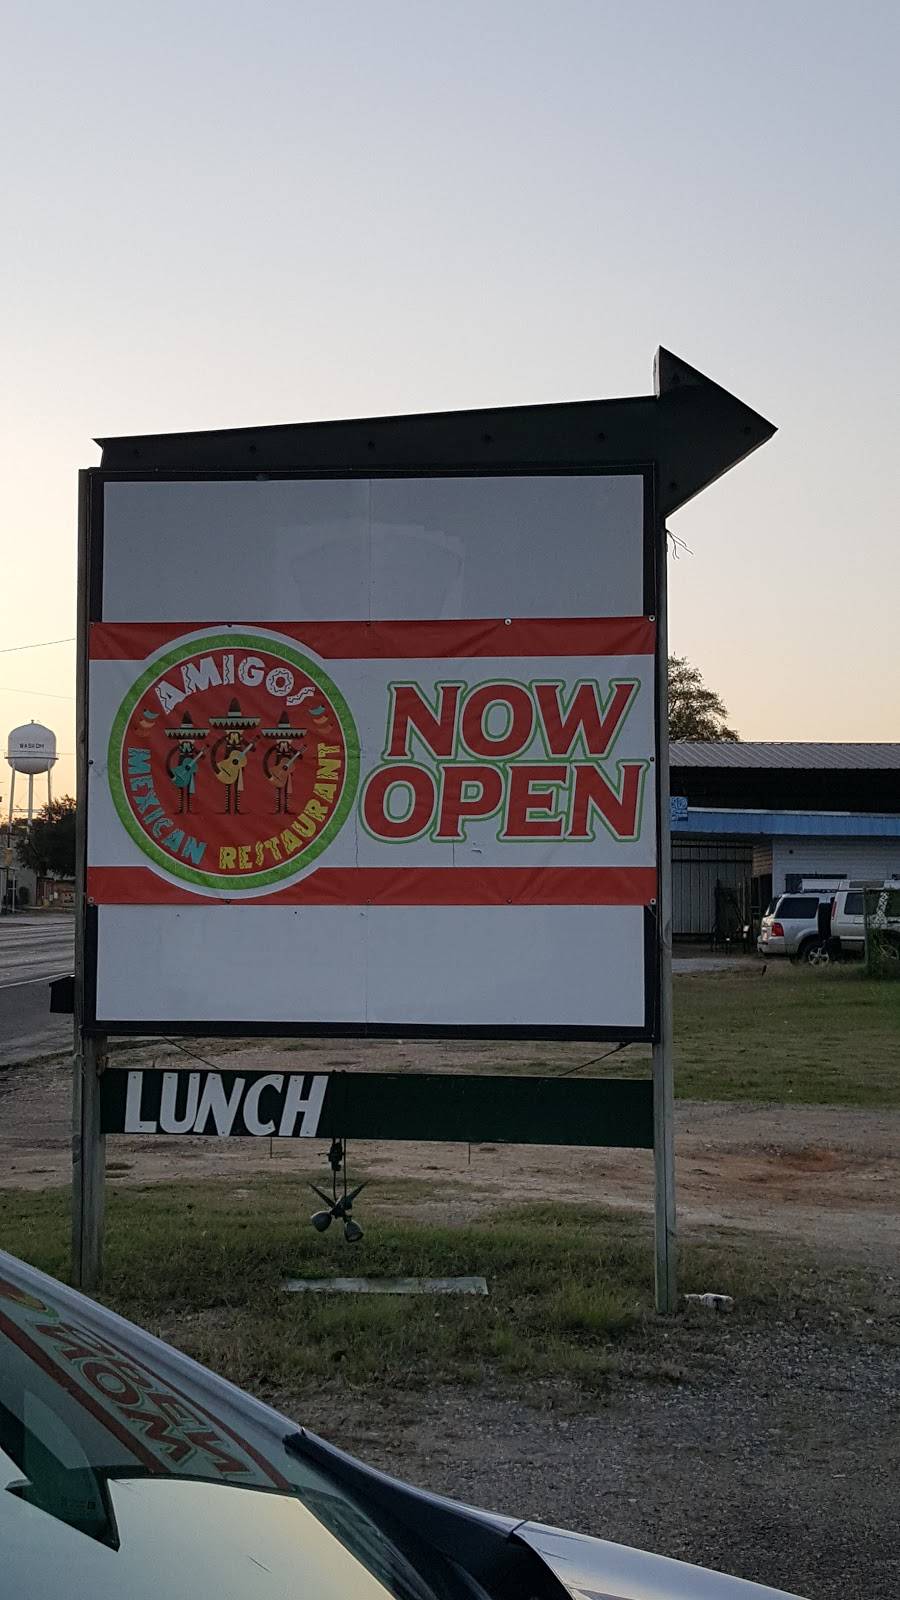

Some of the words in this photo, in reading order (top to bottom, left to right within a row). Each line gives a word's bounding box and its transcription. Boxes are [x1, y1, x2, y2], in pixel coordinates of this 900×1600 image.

[155, 654, 316, 715] AMIGOS
[382, 678, 641, 761] NOW
[127, 746, 208, 866] MEXICAN
[218, 742, 343, 870] RESTAURANT
[358, 759, 650, 844] OPEN
[124, 1071, 329, 1137] LUNCH
